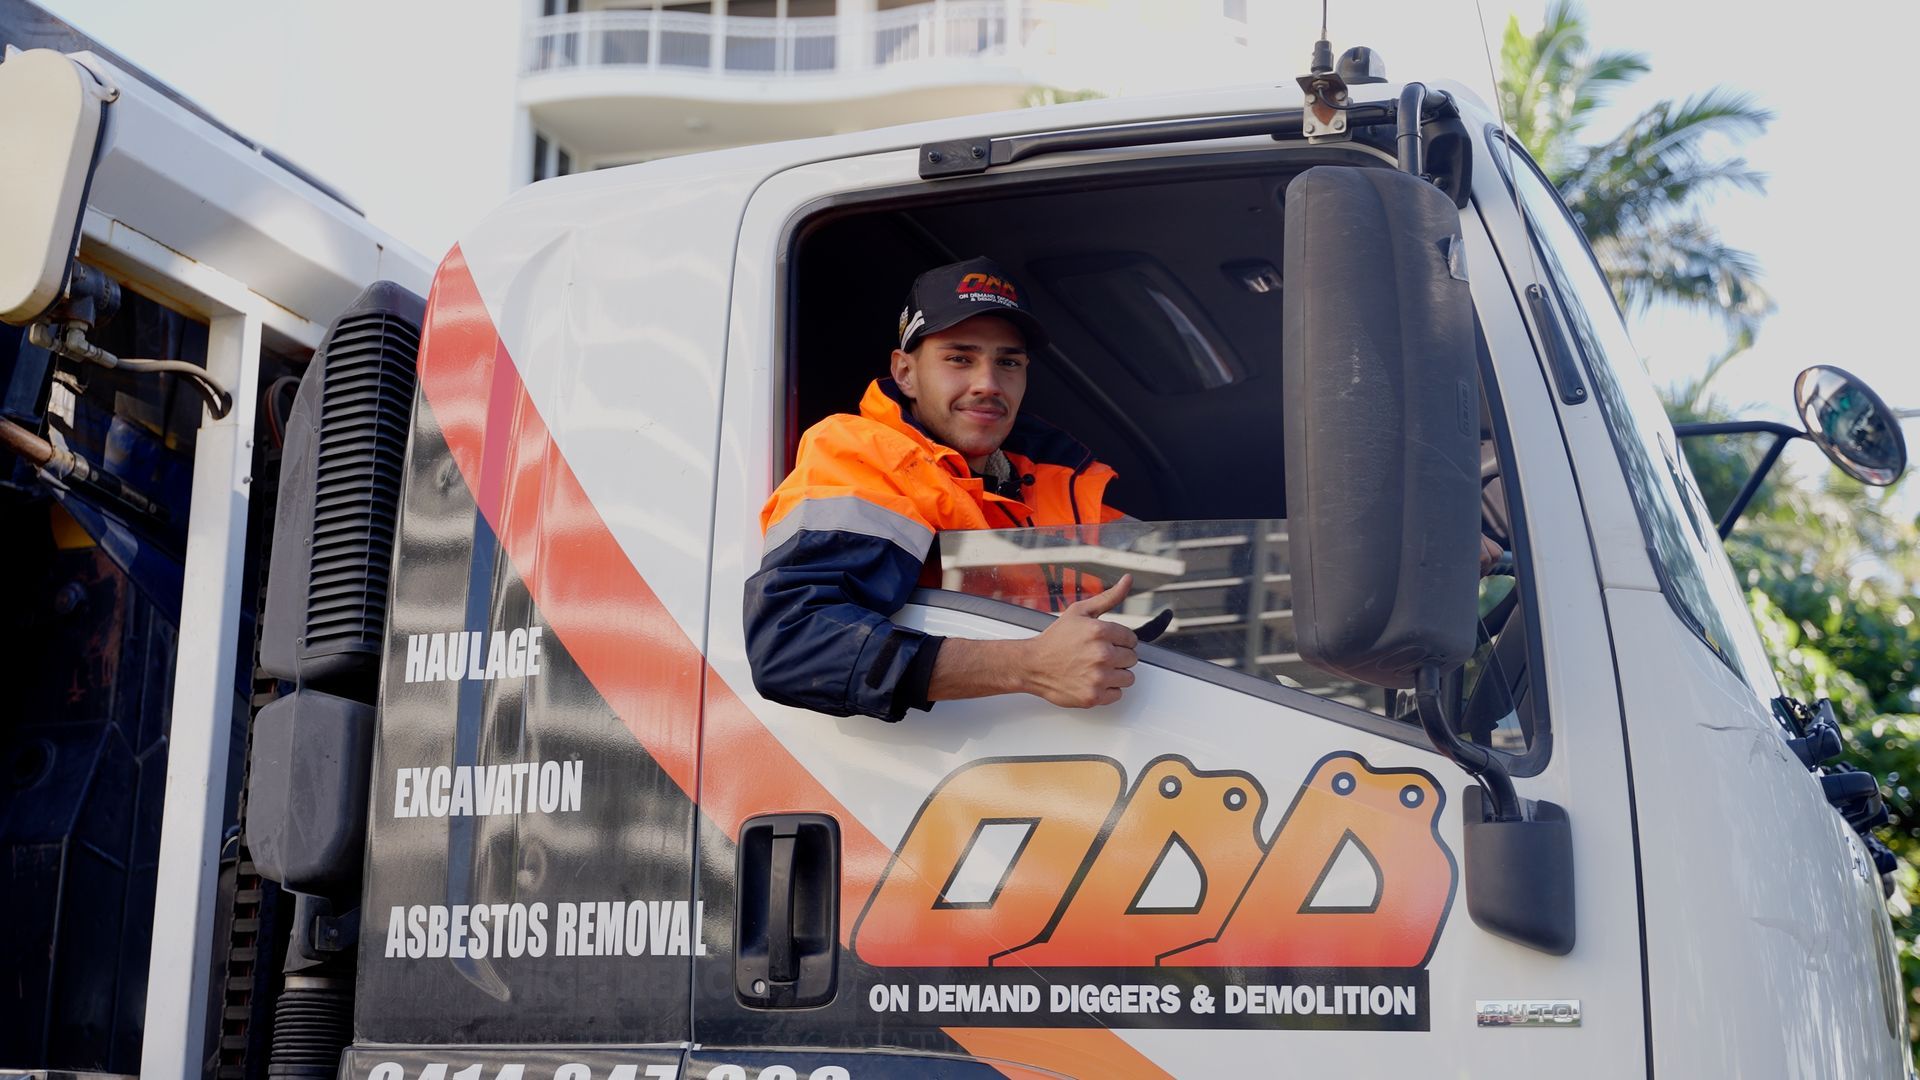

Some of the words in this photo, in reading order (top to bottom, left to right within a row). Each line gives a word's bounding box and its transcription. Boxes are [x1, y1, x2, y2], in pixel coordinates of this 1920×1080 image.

[404, 626, 544, 684] HAULAGE
[393, 759, 584, 819] EXCAVATION
[384, 901, 549, 959] ASBESTOS
[555, 900, 707, 957] REMOVAL
[868, 984, 909, 1013] ON
[918, 984, 1041, 1013] DEMAND
[1050, 984, 1181, 1014] DIGGERS
[1190, 984, 1215, 1014] &
[1225, 985, 1416, 1015] DEMOLITION
